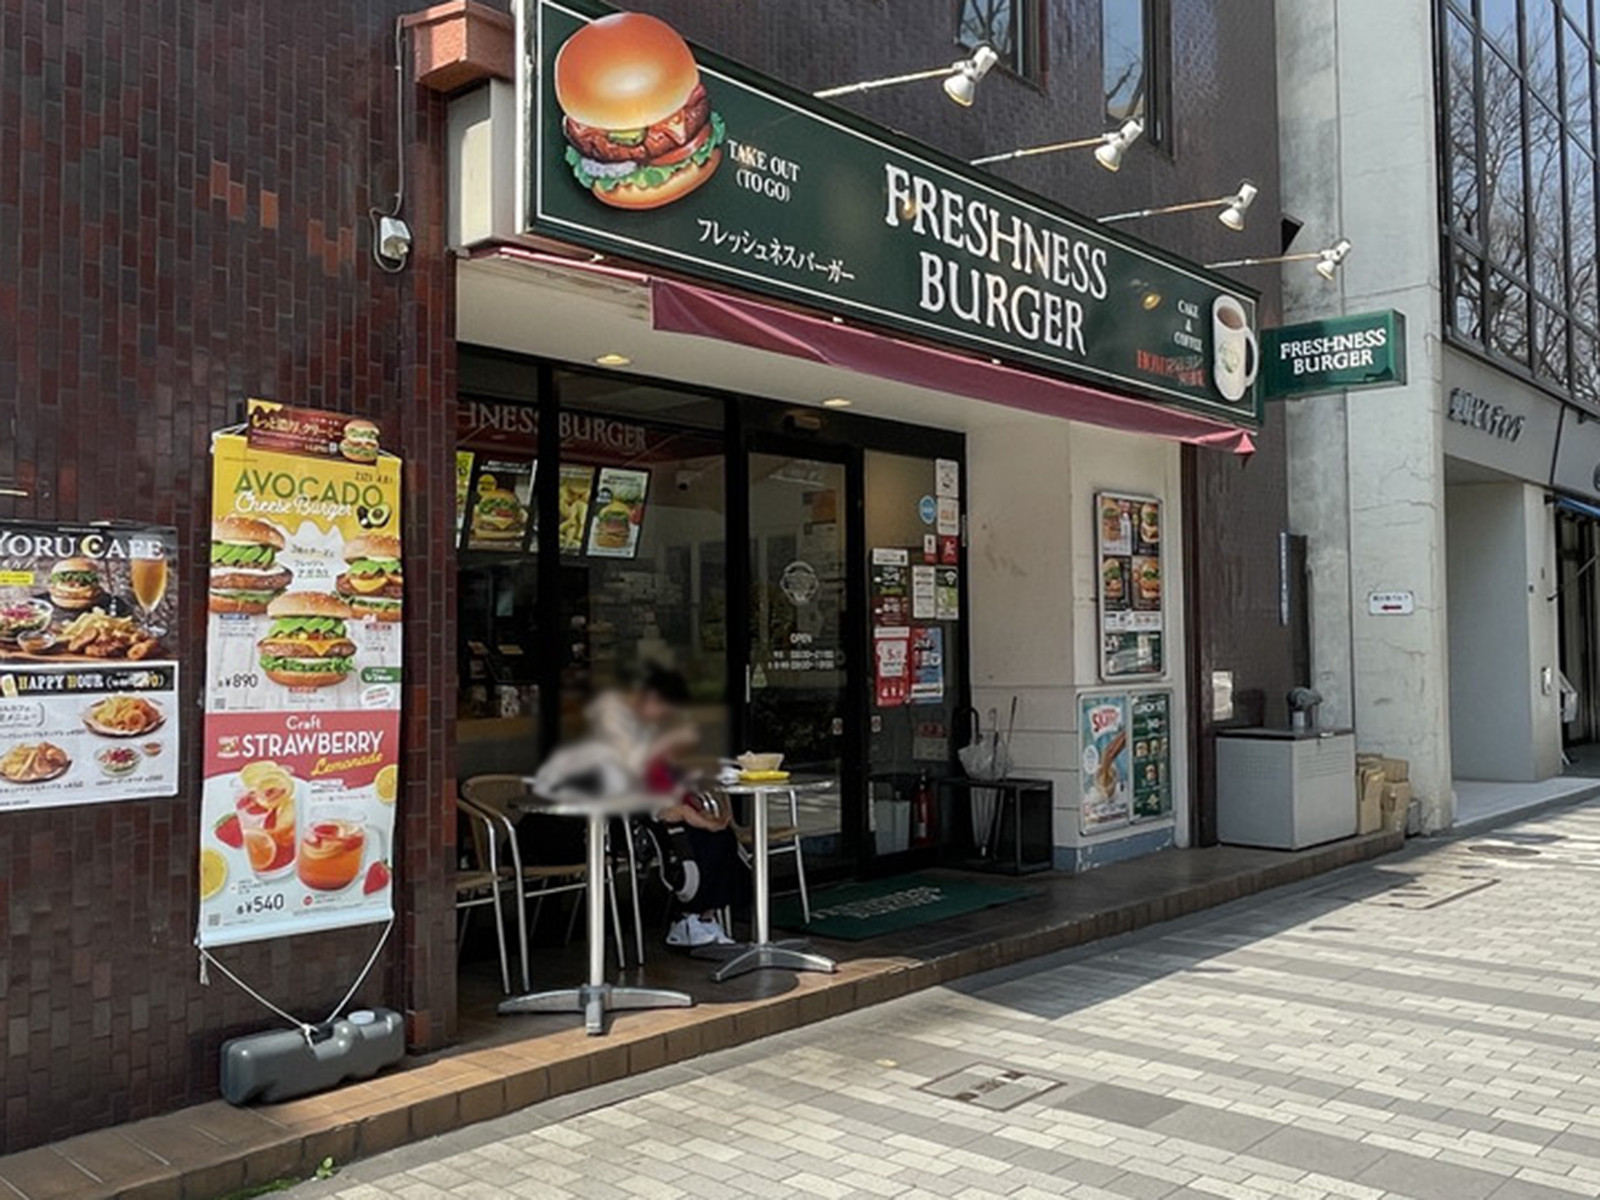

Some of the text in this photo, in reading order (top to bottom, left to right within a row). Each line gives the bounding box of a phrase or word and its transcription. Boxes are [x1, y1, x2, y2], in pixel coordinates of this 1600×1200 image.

[727, 139, 800, 183] TAKE OUT
[736, 169, 791, 203] (TO GO)
[883, 162, 1108, 300] FRESHNESS
[919, 250, 1086, 355] BURGER
[1280, 327, 1387, 360] FRESHNESS
[1293, 348, 1374, 375] BURGER
[558, 411, 647, 449] BURGER
[233, 468, 384, 507] AVOCADO
[235, 489, 353, 519] Cheese Burger
[18, 674, 65, 690] HAPPY
[66, 673, 104, 689] HOUR
[285, 714, 322, 731] Craft
[241, 730, 385, 758] STRAWBERRY
[310, 752, 384, 777] Lemonade
